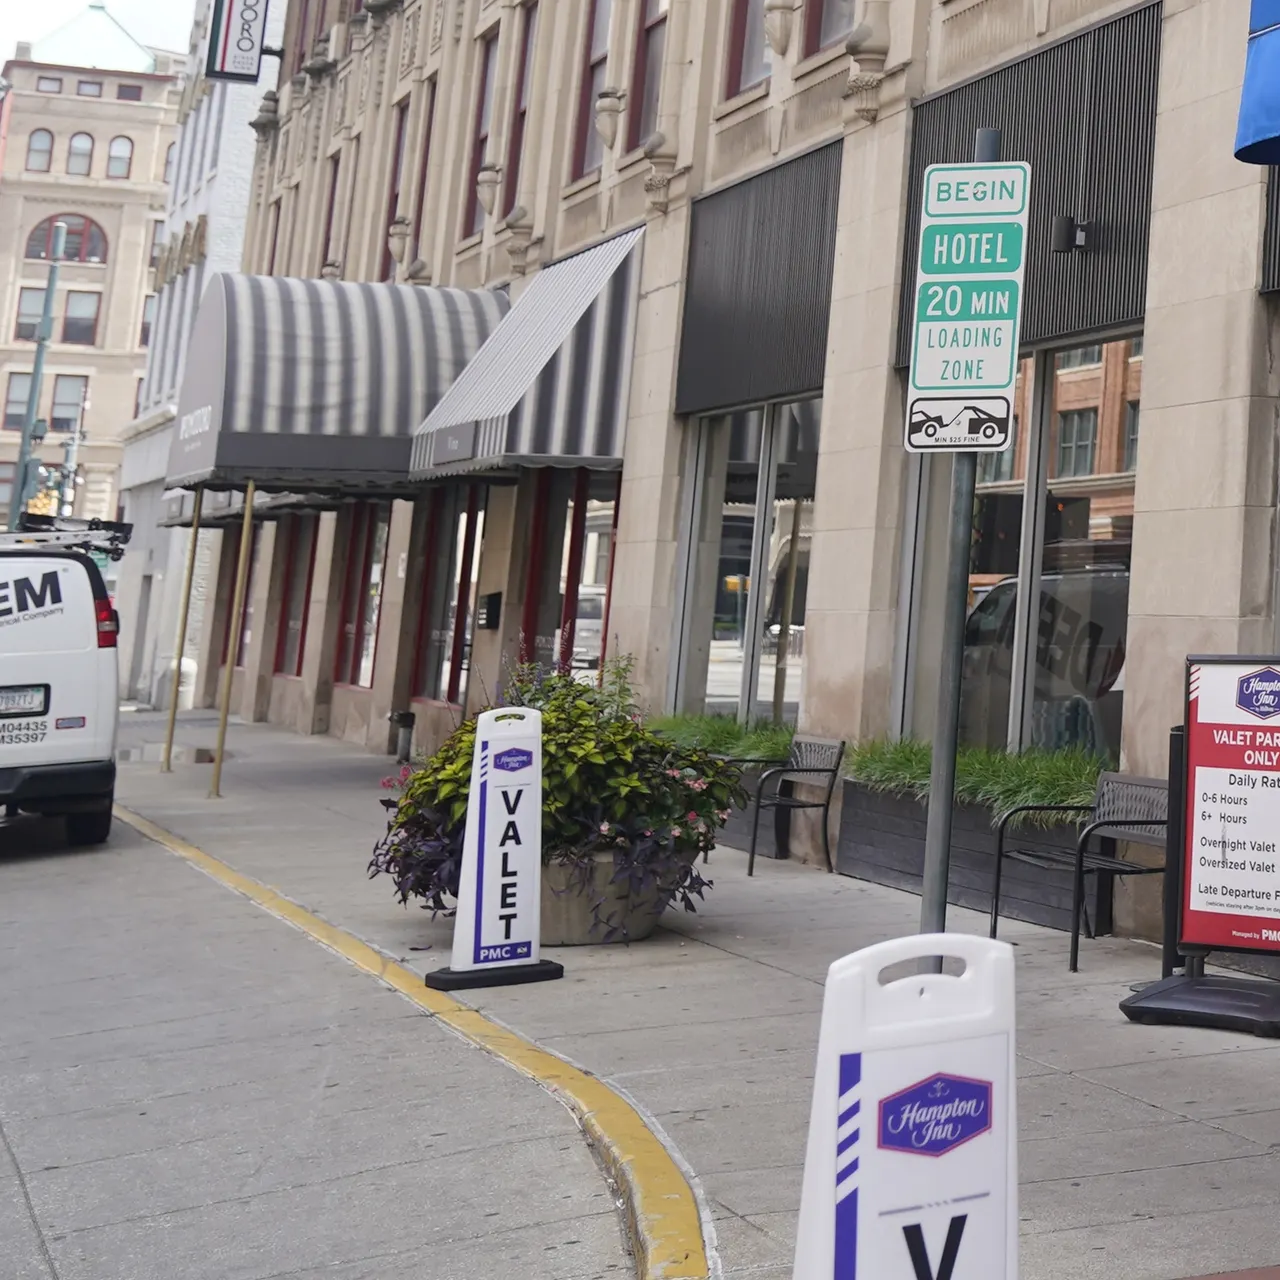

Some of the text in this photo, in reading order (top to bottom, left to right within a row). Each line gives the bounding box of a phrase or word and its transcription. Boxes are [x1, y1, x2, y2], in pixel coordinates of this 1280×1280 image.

[936, 180, 1016, 202] BEGIN
[933, 232, 1008, 264] HOTEL
[926, 285, 1009, 316] 20 MIN
[928, 327, 1003, 349] LOADING
[940, 359, 984, 380] ZONE
[1253, 691, 1278, 706] Inn
[1213, 729, 1253, 746] VALET
[1244, 750, 1280, 766] ONLY
[1228, 773, 1257, 789] Daily
[1202, 792, 1218, 803] 0-6
[1220, 794, 1248, 806] Hours
[1201, 811, 1212, 821] 6+
[1219, 812, 1248, 824] Hours
[1200, 836, 1246, 852] Overnight
[1250, 840, 1276, 853] Valet
[499, 789, 523, 939] VALET
[1199, 856, 1246, 871] Oversized
[1249, 861, 1275, 873] Valet
[1198, 883, 1218, 895] Late
[1221, 885, 1272, 900] Departure
[480, 946, 511, 961] PMC
[888, 1098, 984, 1134] Hampton
[912, 1120, 961, 1147] Inn
